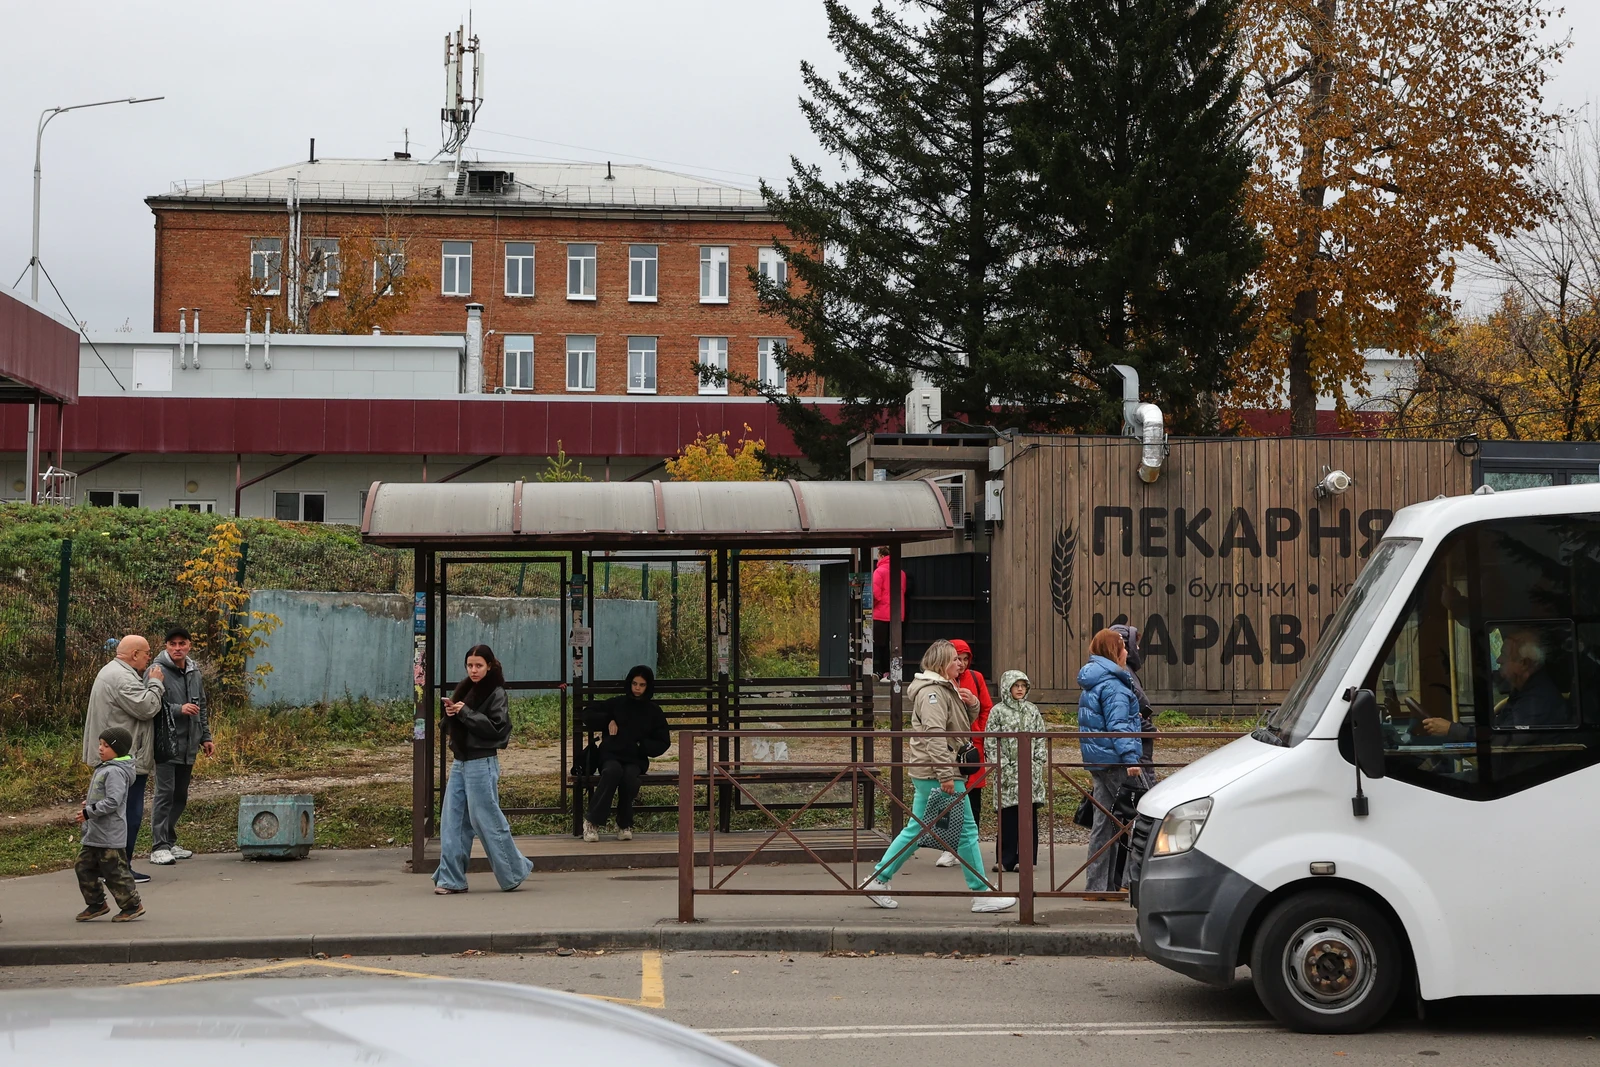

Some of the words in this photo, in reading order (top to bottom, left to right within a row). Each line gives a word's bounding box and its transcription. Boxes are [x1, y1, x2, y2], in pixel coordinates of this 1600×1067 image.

[1093, 506, 1394, 558] ПЕКАРНЯ
[1093, 577, 1153, 597] хлеб
[1188, 577, 1296, 602] булочки
[1092, 613, 1336, 665] АРАВ
